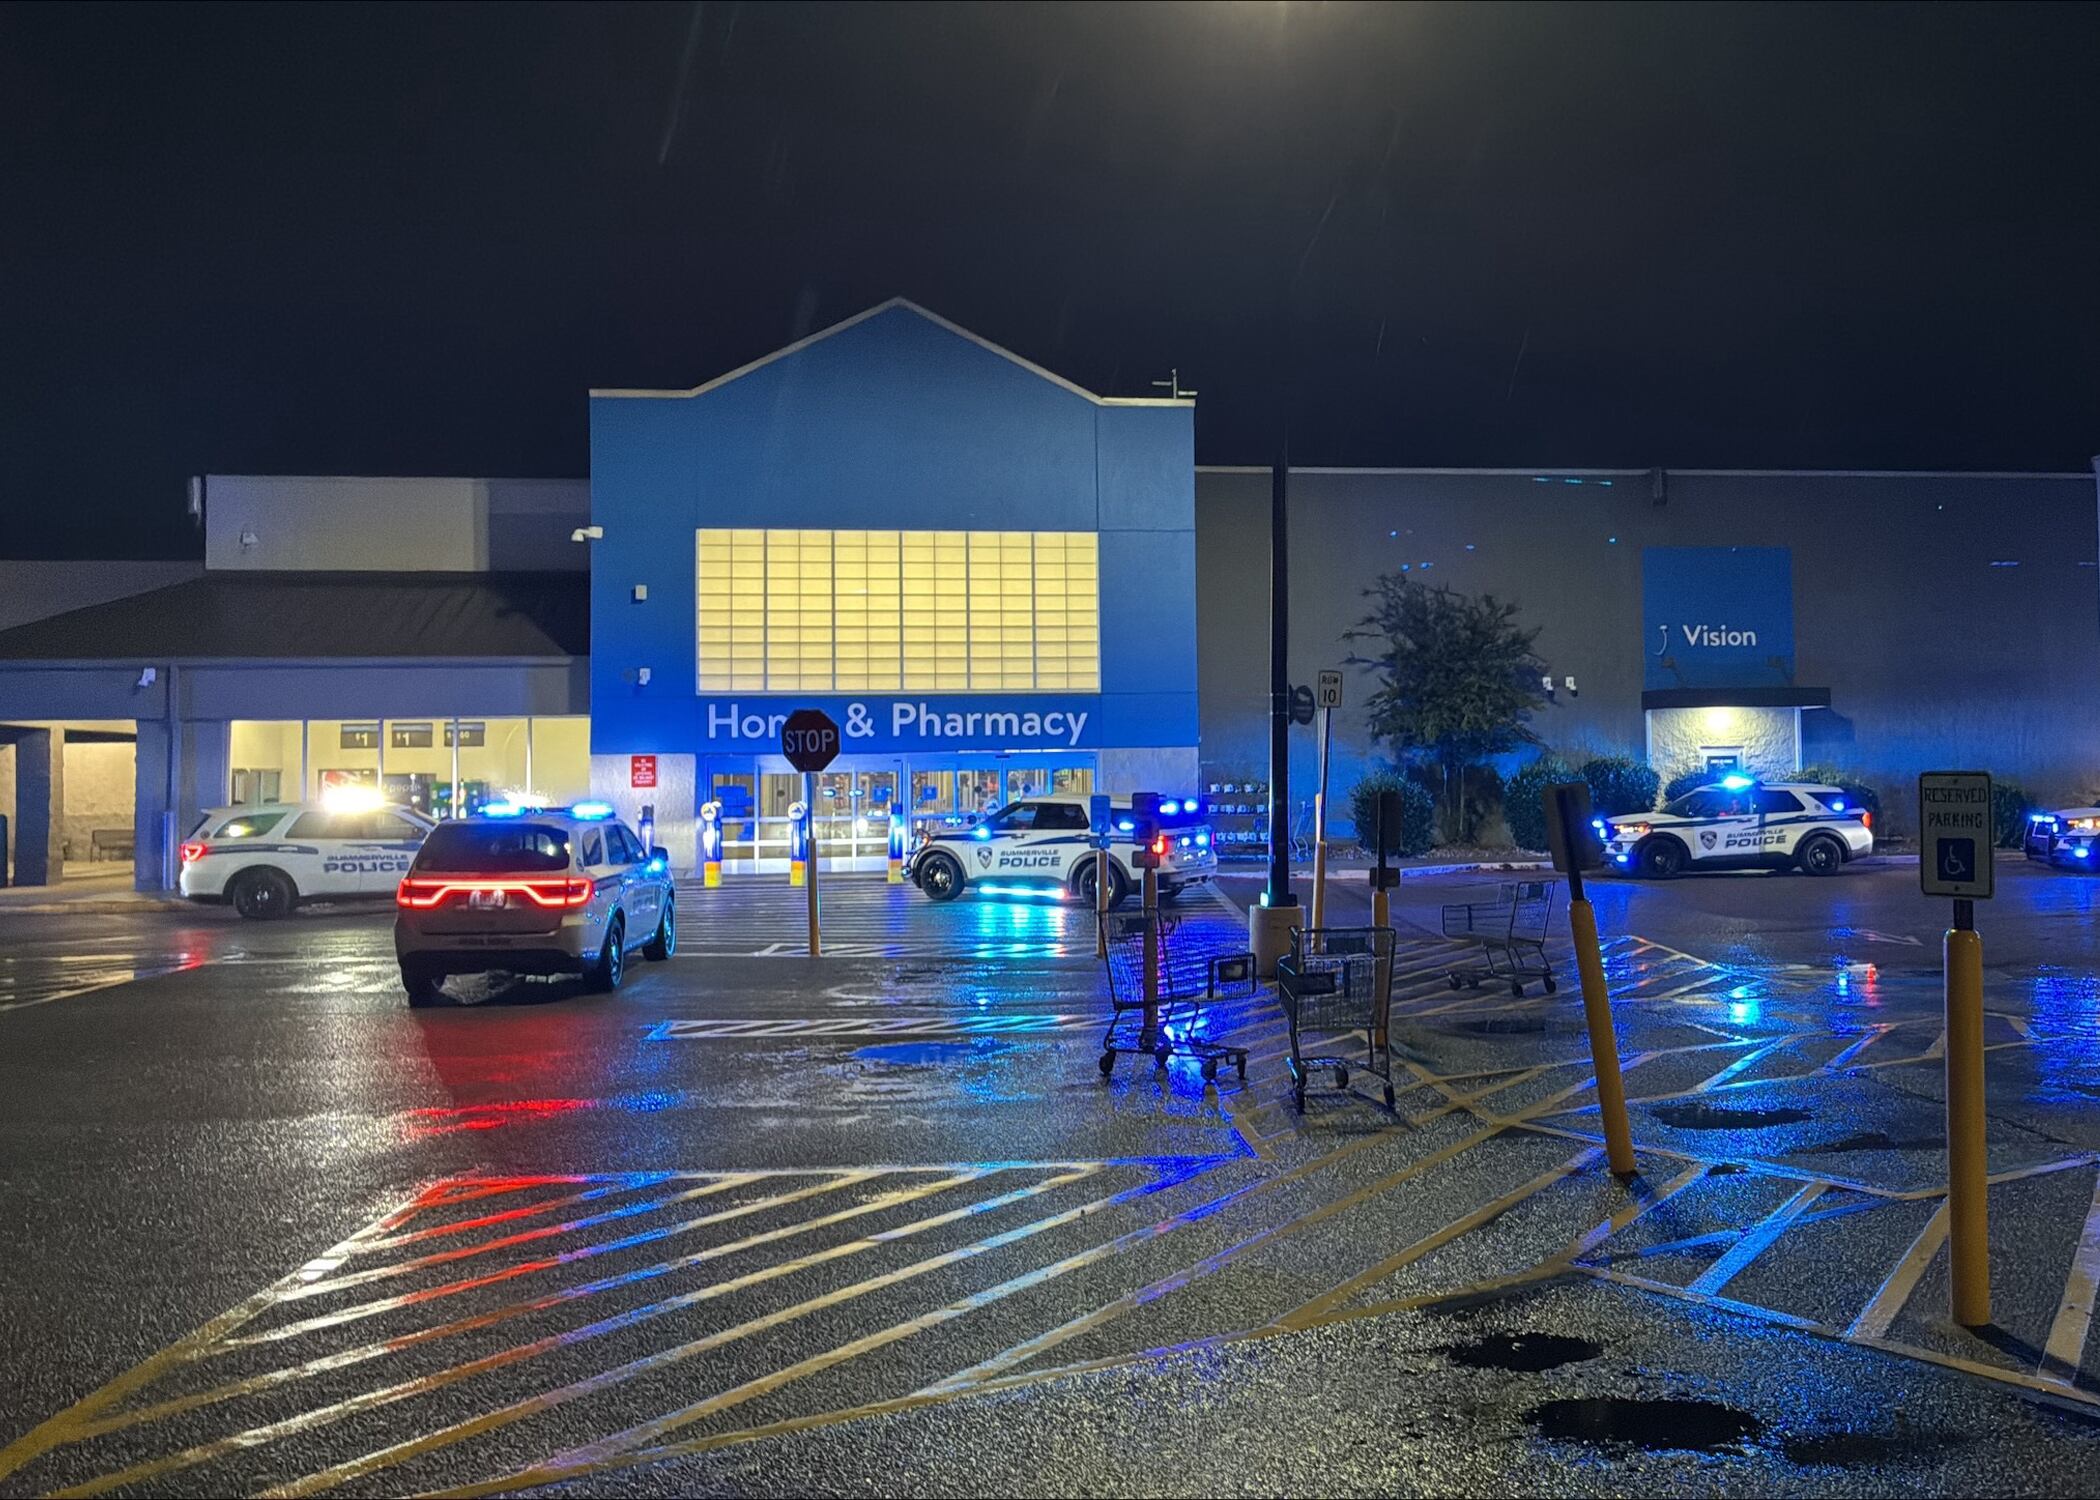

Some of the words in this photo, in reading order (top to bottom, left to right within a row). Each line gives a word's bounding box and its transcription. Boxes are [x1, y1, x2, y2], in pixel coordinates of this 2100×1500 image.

[1682, 625, 1756, 646] Vision
[1323, 689, 1337, 703] 10
[708, 704, 788, 739] Ho
[845, 703, 876, 738] &
[892, 702, 1088, 746] Pharmacy
[785, 729, 835, 754] STOP
[1924, 786, 1987, 803] RESERVED
[1928, 812, 1983, 829] PARKING
[1725, 835, 1787, 849] POLICE
[1000, 849, 1059, 857] SUMMERVILLE
[323, 861, 409, 873] POLICE
[999, 856, 1062, 869] POLICE
